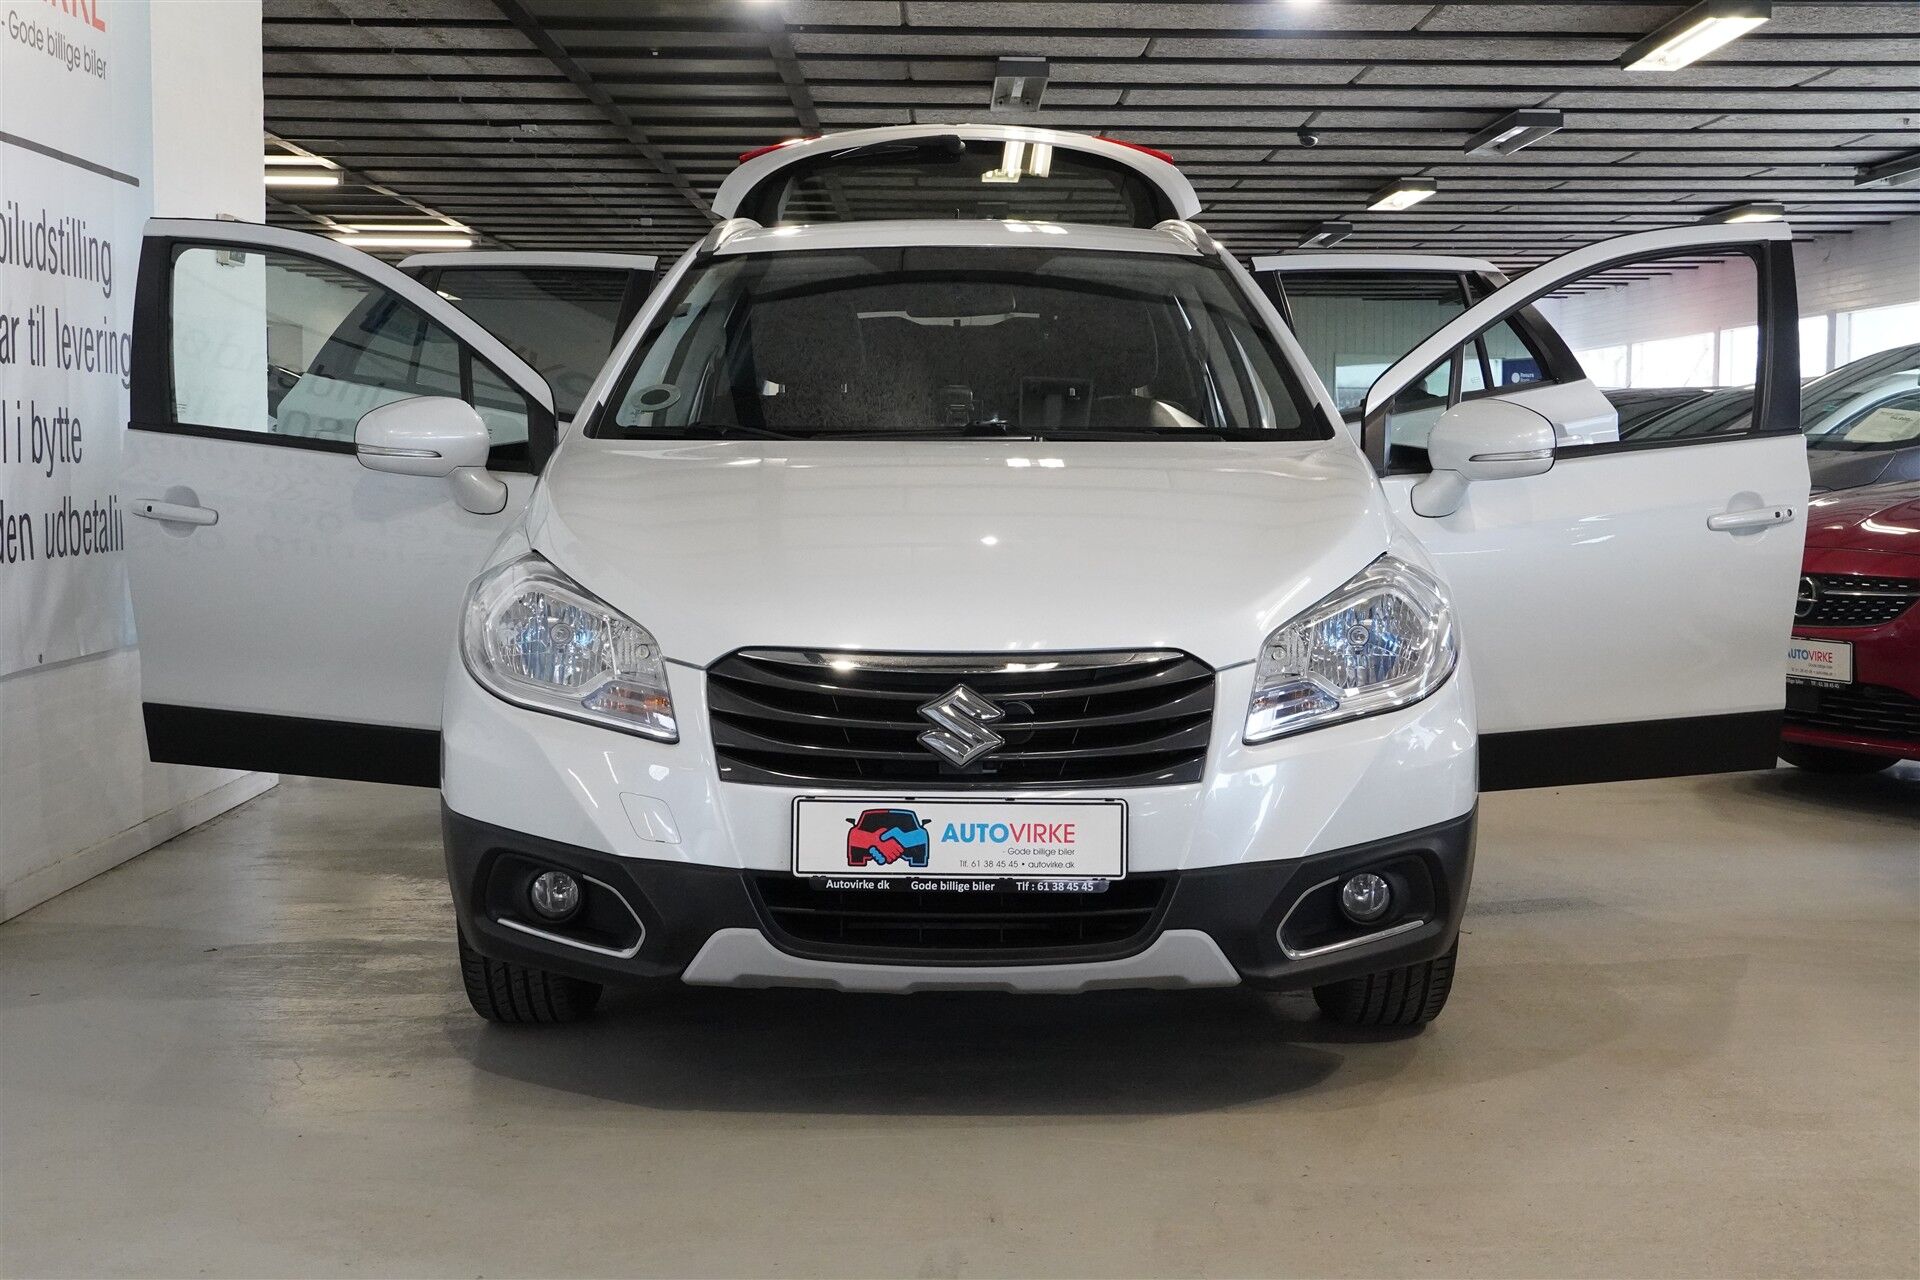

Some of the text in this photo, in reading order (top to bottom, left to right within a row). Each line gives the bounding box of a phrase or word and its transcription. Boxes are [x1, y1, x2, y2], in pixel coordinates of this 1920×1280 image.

[8, 9, 44, 51] Gode
[46, 26, 81, 72] billige
[83, 44, 107, 80] biler
[0, 304, 132, 390] ar til levering
[16, 400, 21, 463] i
[31, 399, 82, 478] bytte
[940, 822, 1076, 844] AUTOVIRKE
[1007, 847, 1031, 856] Gode
[1032, 847, 1057, 858] billige
[1057, 847, 1075, 856] biler
[970, 859, 980, 868] 61
[983, 859, 994, 868] 38
[996, 859, 1007, 868] 45
[1008, 859, 1019, 869] 45
[825, 879, 875, 890] Autovirke
[877, 879, 890, 890] dk
[910, 880, 938, 891] Gode
[939, 881, 970, 893] billige
[972, 881, 996, 892] biler
[1015, 881, 1030, 891] Tlf
[1037, 881, 1050, 892] 61
[1051, 881, 1065, 892] 38
[1066, 881, 1079, 892] 45
[1080, 881, 1094, 892] 45
